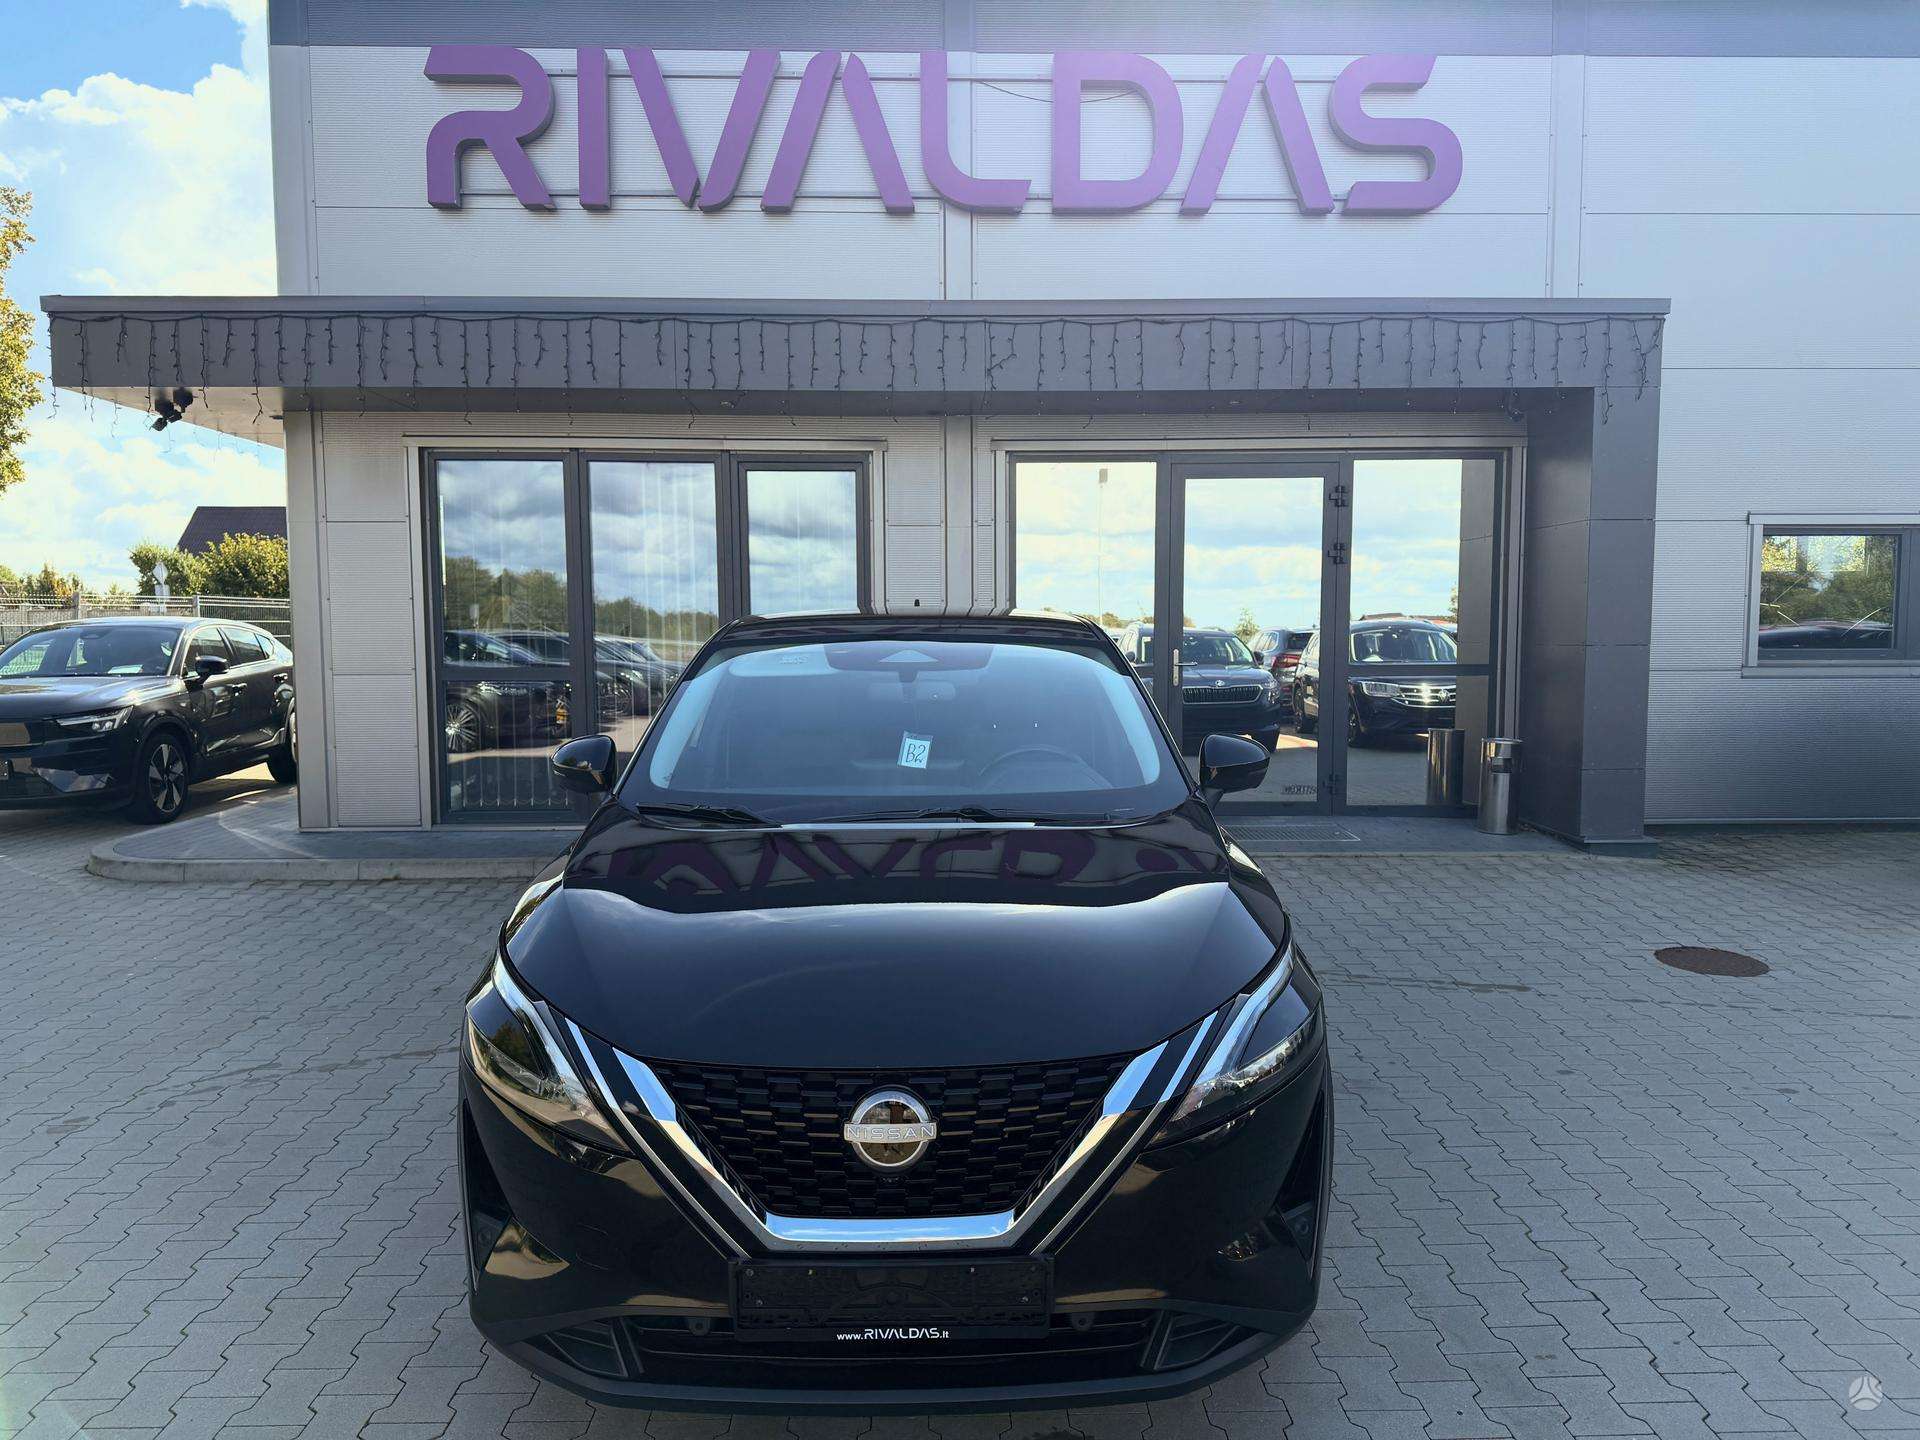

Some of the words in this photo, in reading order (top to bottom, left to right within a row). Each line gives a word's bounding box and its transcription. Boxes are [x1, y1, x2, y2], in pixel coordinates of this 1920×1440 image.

[424, 46, 1463, 216] RIVALDAS
[906, 743, 926, 763] B2
[846, 1124, 935, 1140] NISSAN
[836, 1327, 950, 1341] www.RIVALDAS.lt
